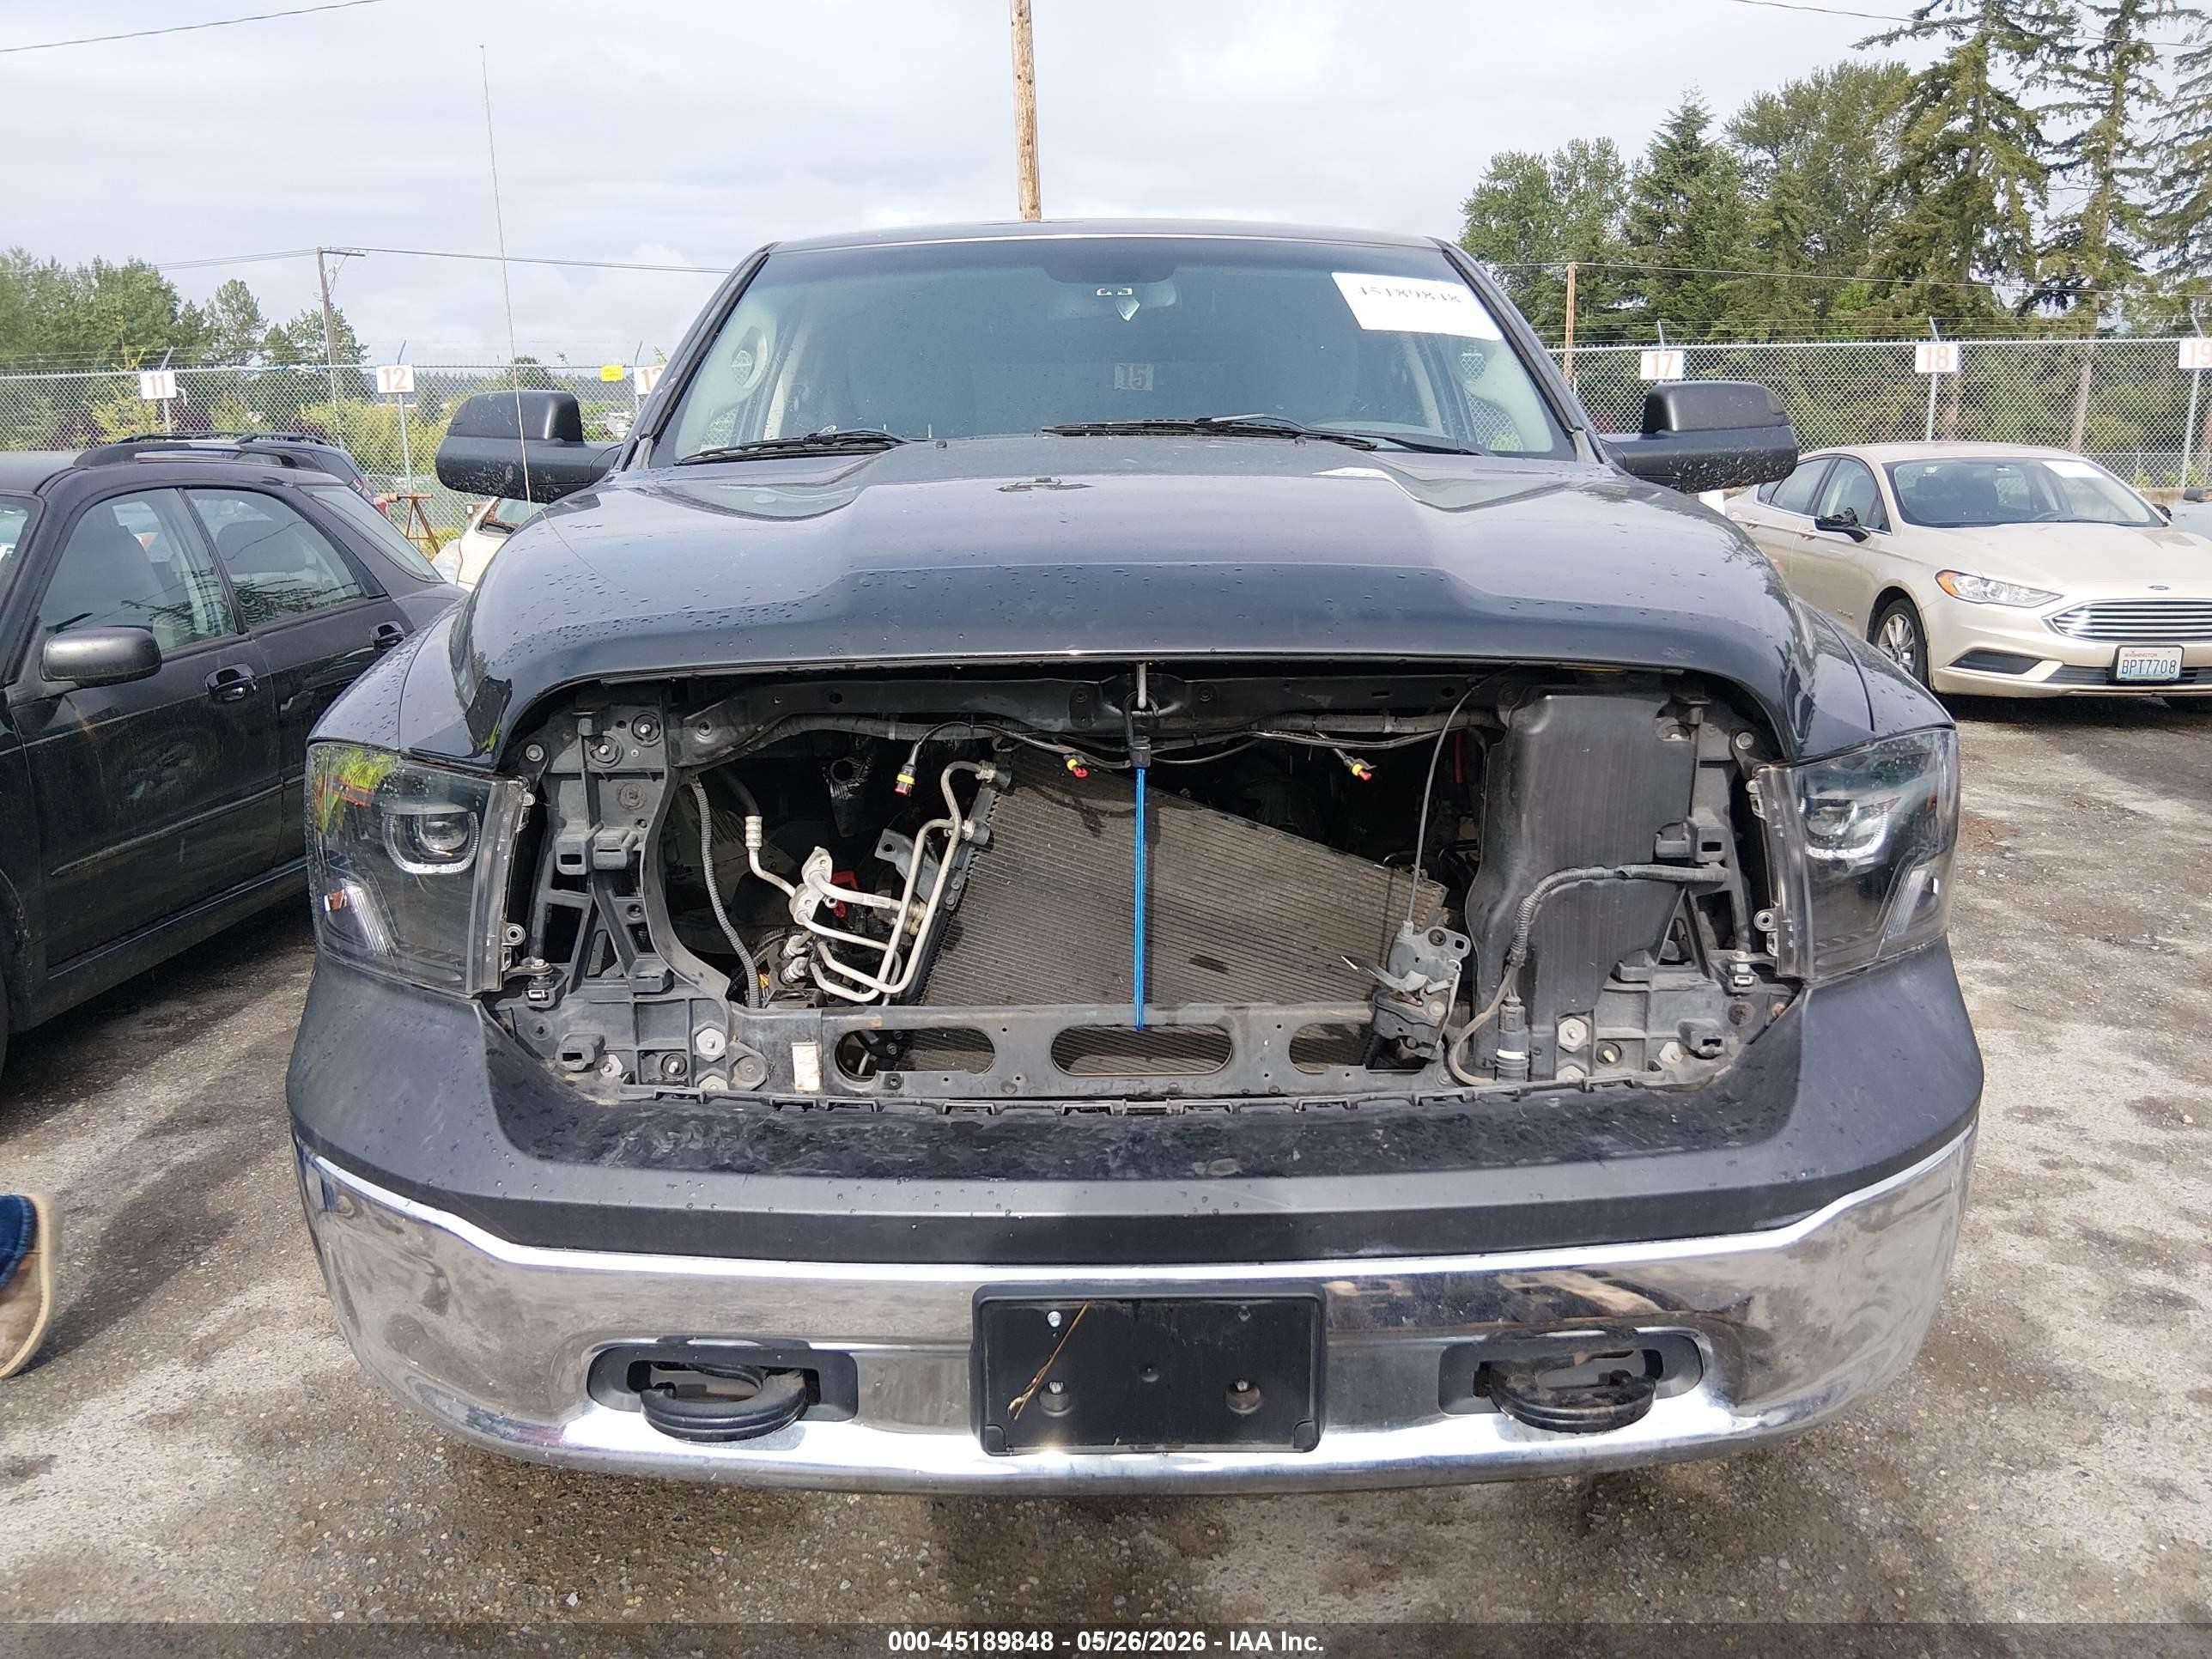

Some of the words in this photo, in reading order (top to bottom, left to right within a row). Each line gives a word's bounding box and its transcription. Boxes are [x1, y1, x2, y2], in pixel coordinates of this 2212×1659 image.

[1651, 353, 1674, 377] 17
[1924, 345, 1950, 371] 18
[2189, 342, 2212, 366] 19
[149, 374, 166, 397] 11
[383, 368, 407, 391] 12
[2122, 659, 2176, 674] BPT7708
